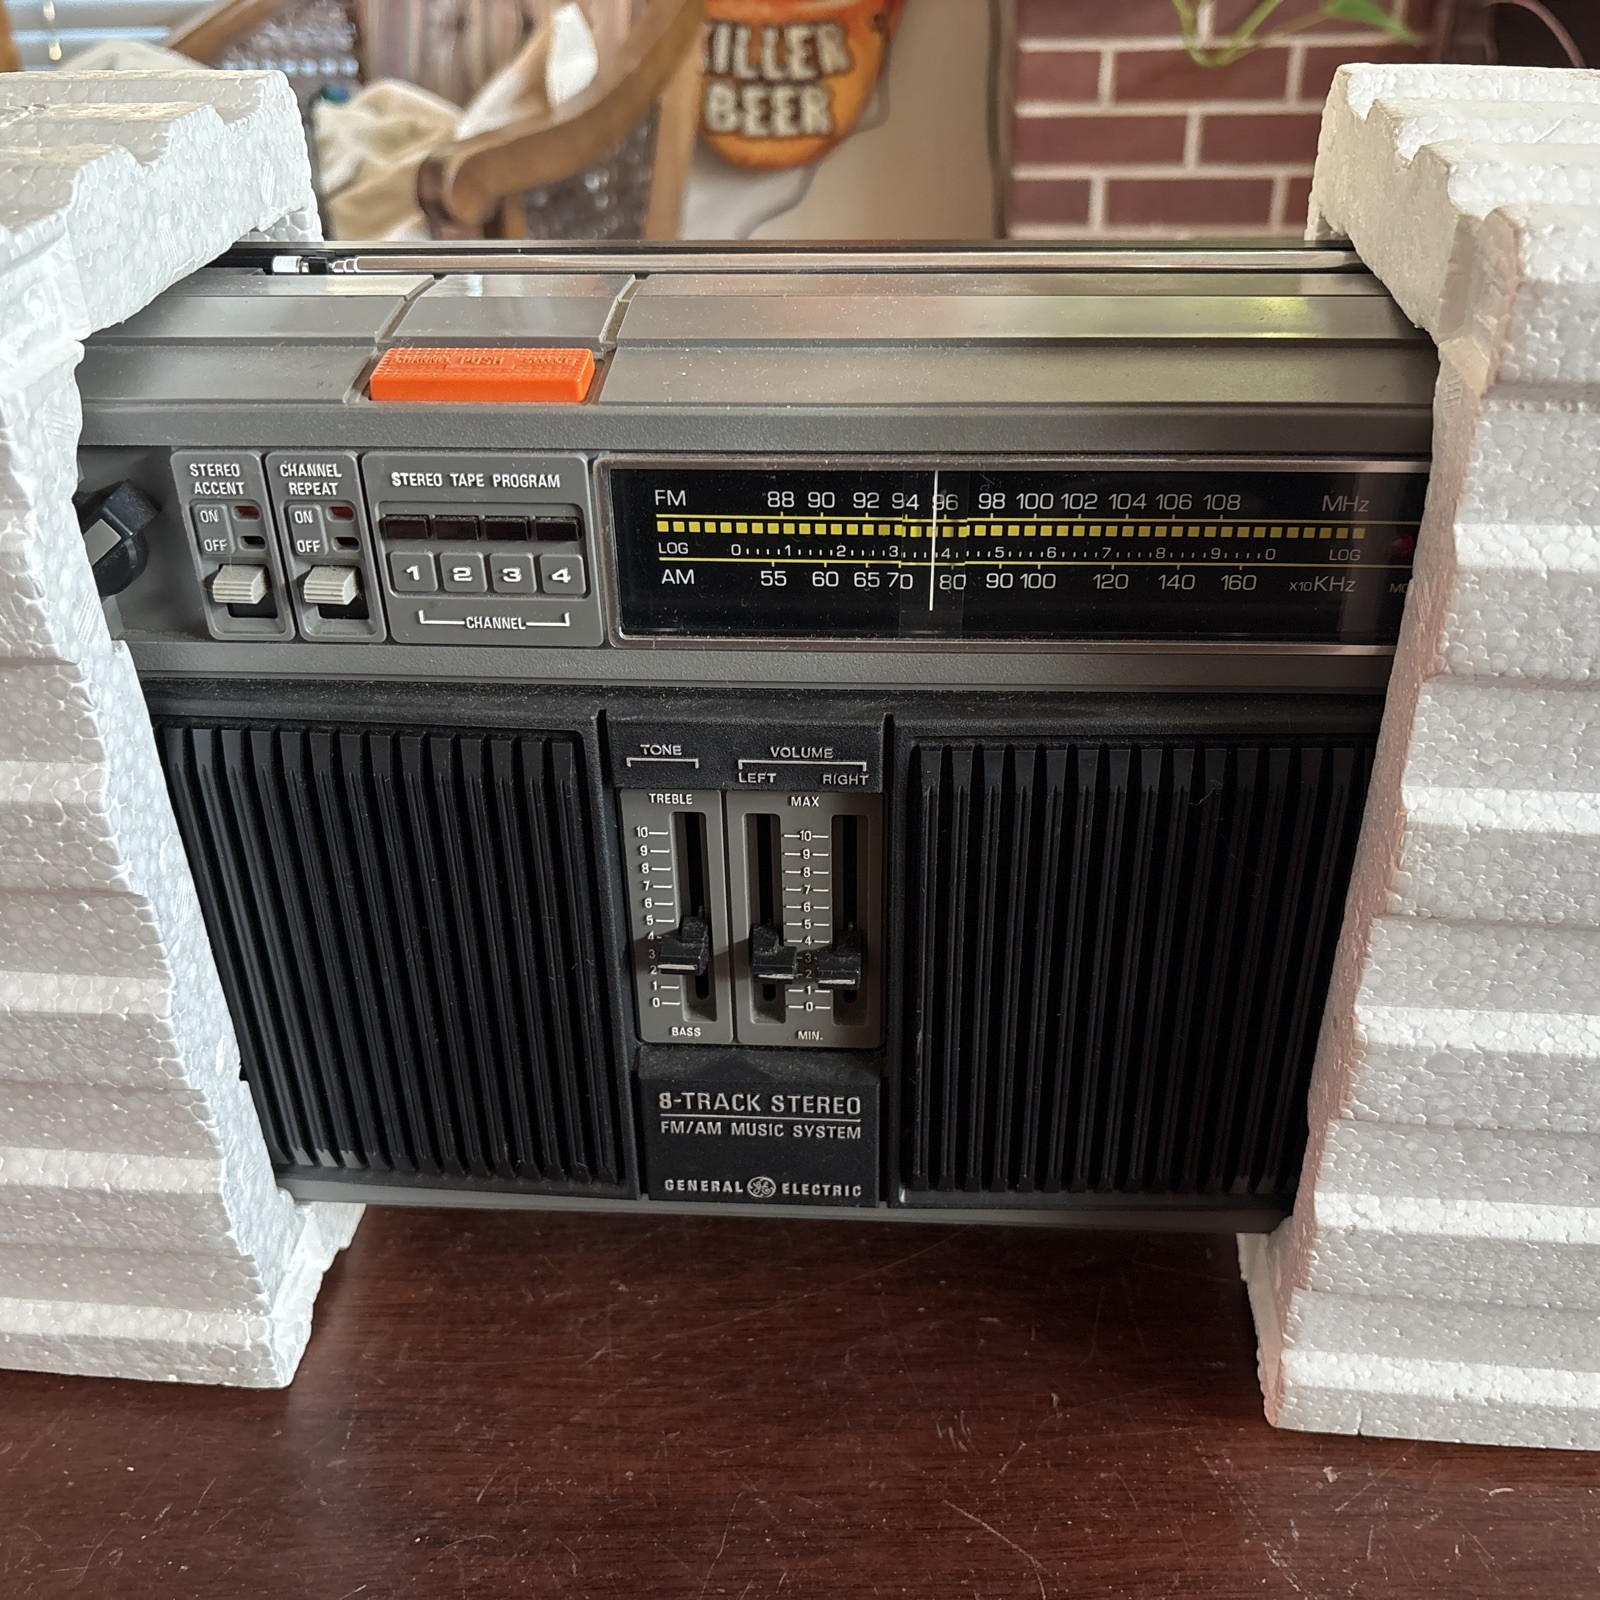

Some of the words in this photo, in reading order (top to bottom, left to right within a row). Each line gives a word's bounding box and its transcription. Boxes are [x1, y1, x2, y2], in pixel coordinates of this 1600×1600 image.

[704, 22, 849, 81] ILLER
[706, 82, 831, 138] BEER
[459, 355, 505, 365] PUSH
[190, 463, 240, 478] STEREO
[279, 463, 343, 478] CHANNEL
[391, 472, 443, 488] STEREO
[450, 473, 485, 488] TAPE
[492, 473, 561, 489] PROGRAM
[194, 481, 245, 496] ACCENT
[288, 482, 339, 496] REPEAT
[655, 490, 687, 507] FM
[767, 491, 795, 508] 88
[807, 492, 836, 509] 90
[853, 493, 880, 509] 92
[892, 493, 920, 511] 94
[932, 494, 959, 511] 96
[978, 493, 1006, 510] 98
[1016, 493, 1054, 510] 100
[1060, 493, 1098, 510] 102
[1108, 493, 1147, 510] 104
[1155, 493, 1193, 510] 106
[1203, 494, 1241, 511] 108
[1321, 495, 1370, 512] MHz
[200, 509, 218, 524] ON
[295, 509, 314, 524] ON
[204, 538, 228, 553] OFF
[297, 539, 321, 553] OFF
[658, 542, 689, 554] LOG
[731, 544, 741, 556] 0
[785, 544, 791, 556] 1
[836, 545, 846, 557] 2
[888, 546, 899, 558] 3
[940, 547, 951, 559] 4
[995, 547, 1005, 559] 5
[1046, 547, 1057, 559] 6
[1102, 547, 1112, 559] 7
[1155, 548, 1166, 559] 8
[1211, 548, 1221, 560] 9
[1265, 549, 1276, 560] 0
[1329, 549, 1361, 562] LOG
[406, 566, 420, 581] 1
[453, 567, 473, 582] 2
[502, 567, 522, 582] 3
[551, 568, 572, 583] 4
[661, 569, 695, 585] AM
[760, 570, 787, 587] 55
[812, 571, 839, 588] 60
[853, 572, 880, 588] 65
[887, 573, 914, 590] 70
[939, 574, 967, 590] 80
[985, 573, 1013, 589] 90
[1019, 573, 1057, 590] 100
[1092, 573, 1129, 590] 120
[1158, 574, 1195, 590] 140
[1220, 574, 1257, 591] 160
[466, 616, 526, 630] CHANNEL
[640, 744, 682, 756] TONE
[770, 746, 833, 759] VOLUME
[738, 772, 776, 784] LEFT
[822, 774, 869, 786] RIGHT
[649, 793, 693, 805] TREBLE
[791, 796, 820, 807] MAX
[636, 826, 648, 838] 10
[800, 830, 812, 842] 10
[640, 845, 648, 856] 9
[802, 849, 810, 860] 9
[641, 863, 650, 874] 8
[803, 867, 811, 878] 8
[643, 881, 650, 891] 7
[803, 884, 811, 895] 7
[644, 898, 652, 908] 6
[803, 902, 811, 912] 6
[646, 915, 654, 926] 5
[804, 919, 812, 929] 5
[647, 931, 655, 941] 4
[804, 936, 812, 946] 4
[648, 949, 656, 959] 3
[804, 953, 812, 963] 3
[650, 965, 658, 975] 2
[805, 970, 813, 979] 2
[652, 997, 660, 1008] 0
[805, 1002, 813, 1012] 0
[671, 1026, 701, 1037] BASS
[798, 1030, 823, 1041] MIN.
[659, 1092, 761, 1112] 8-TRACK
[771, 1095, 861, 1115] STEREO
[660, 1121, 722, 1135] FM/AM
[731, 1122, 785, 1137] MUSIC
[792, 1125, 861, 1139] SYSTEM
[664, 1179, 743, 1193] GENERAL
[782, 1182, 862, 1196] ELECTRIC
